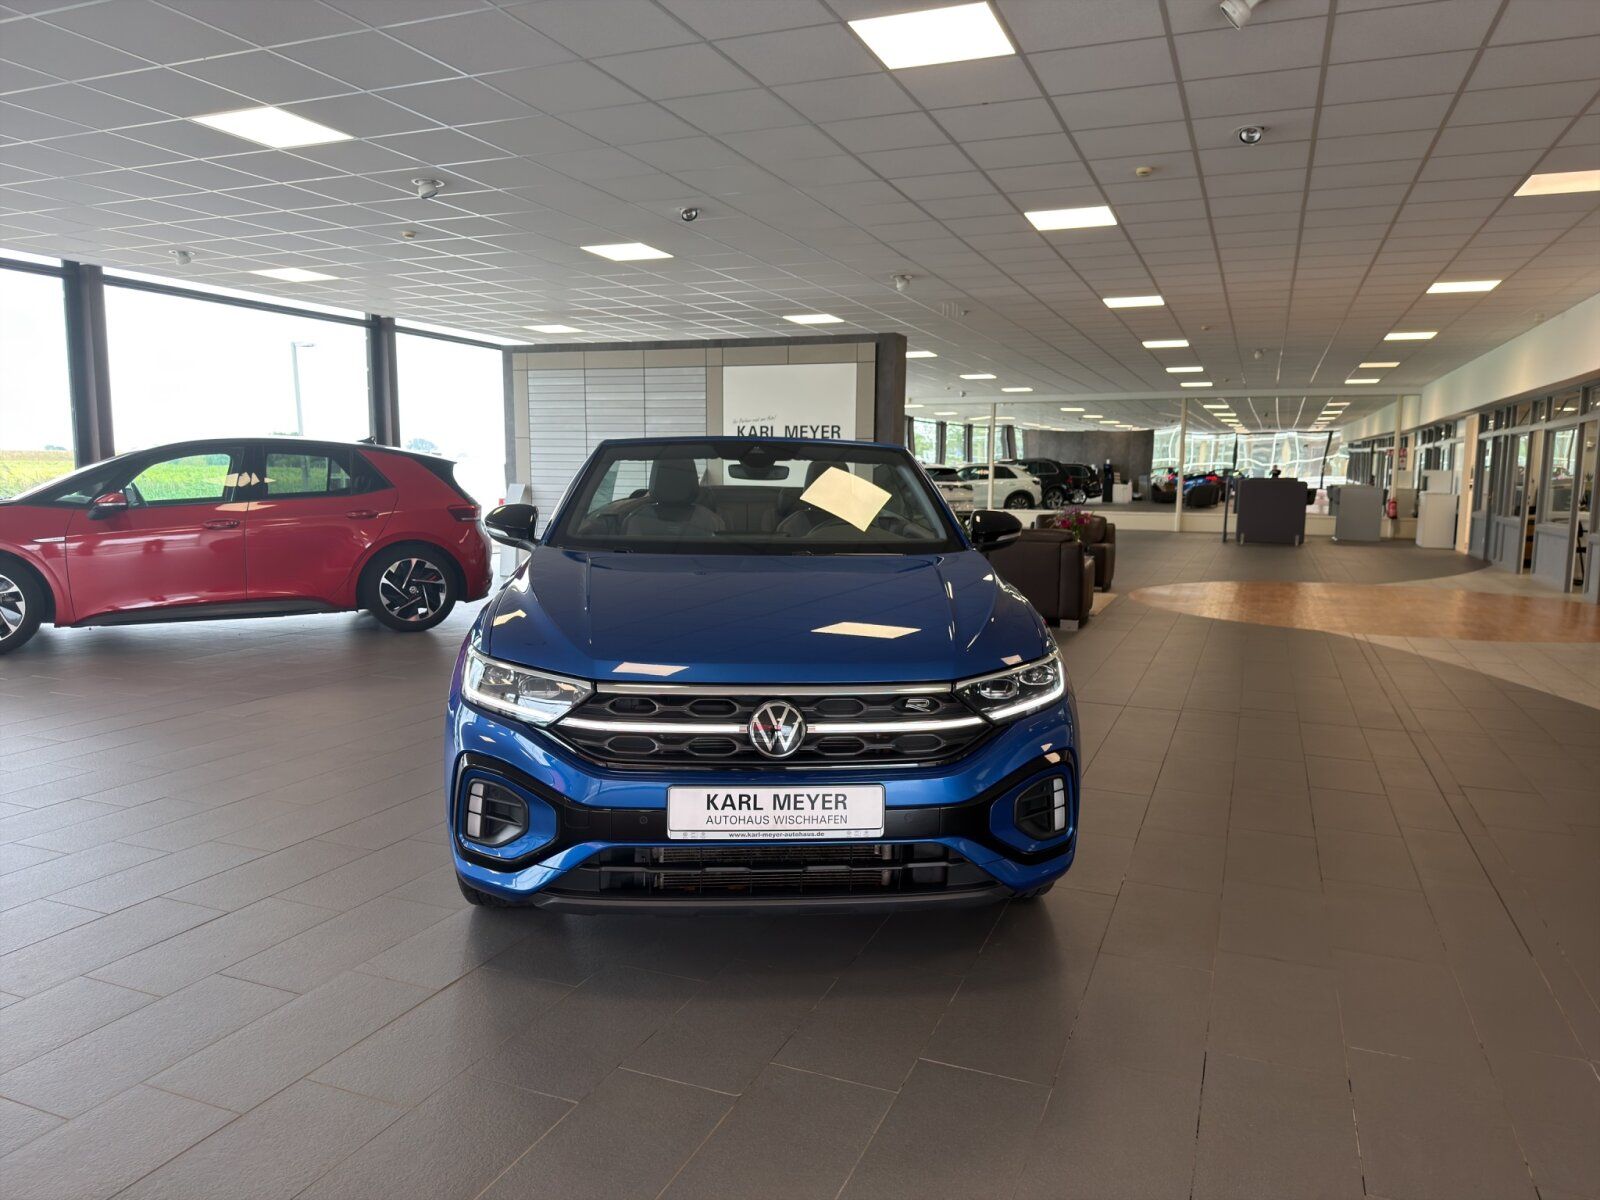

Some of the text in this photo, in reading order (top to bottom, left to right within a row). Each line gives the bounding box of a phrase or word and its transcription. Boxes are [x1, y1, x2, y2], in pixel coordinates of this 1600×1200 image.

[737, 425, 841, 439] KARL MEYER
[706, 793, 848, 811] KARL MEYER
[706, 814, 848, 825] AUTOHAUS WISCHHAFEN
